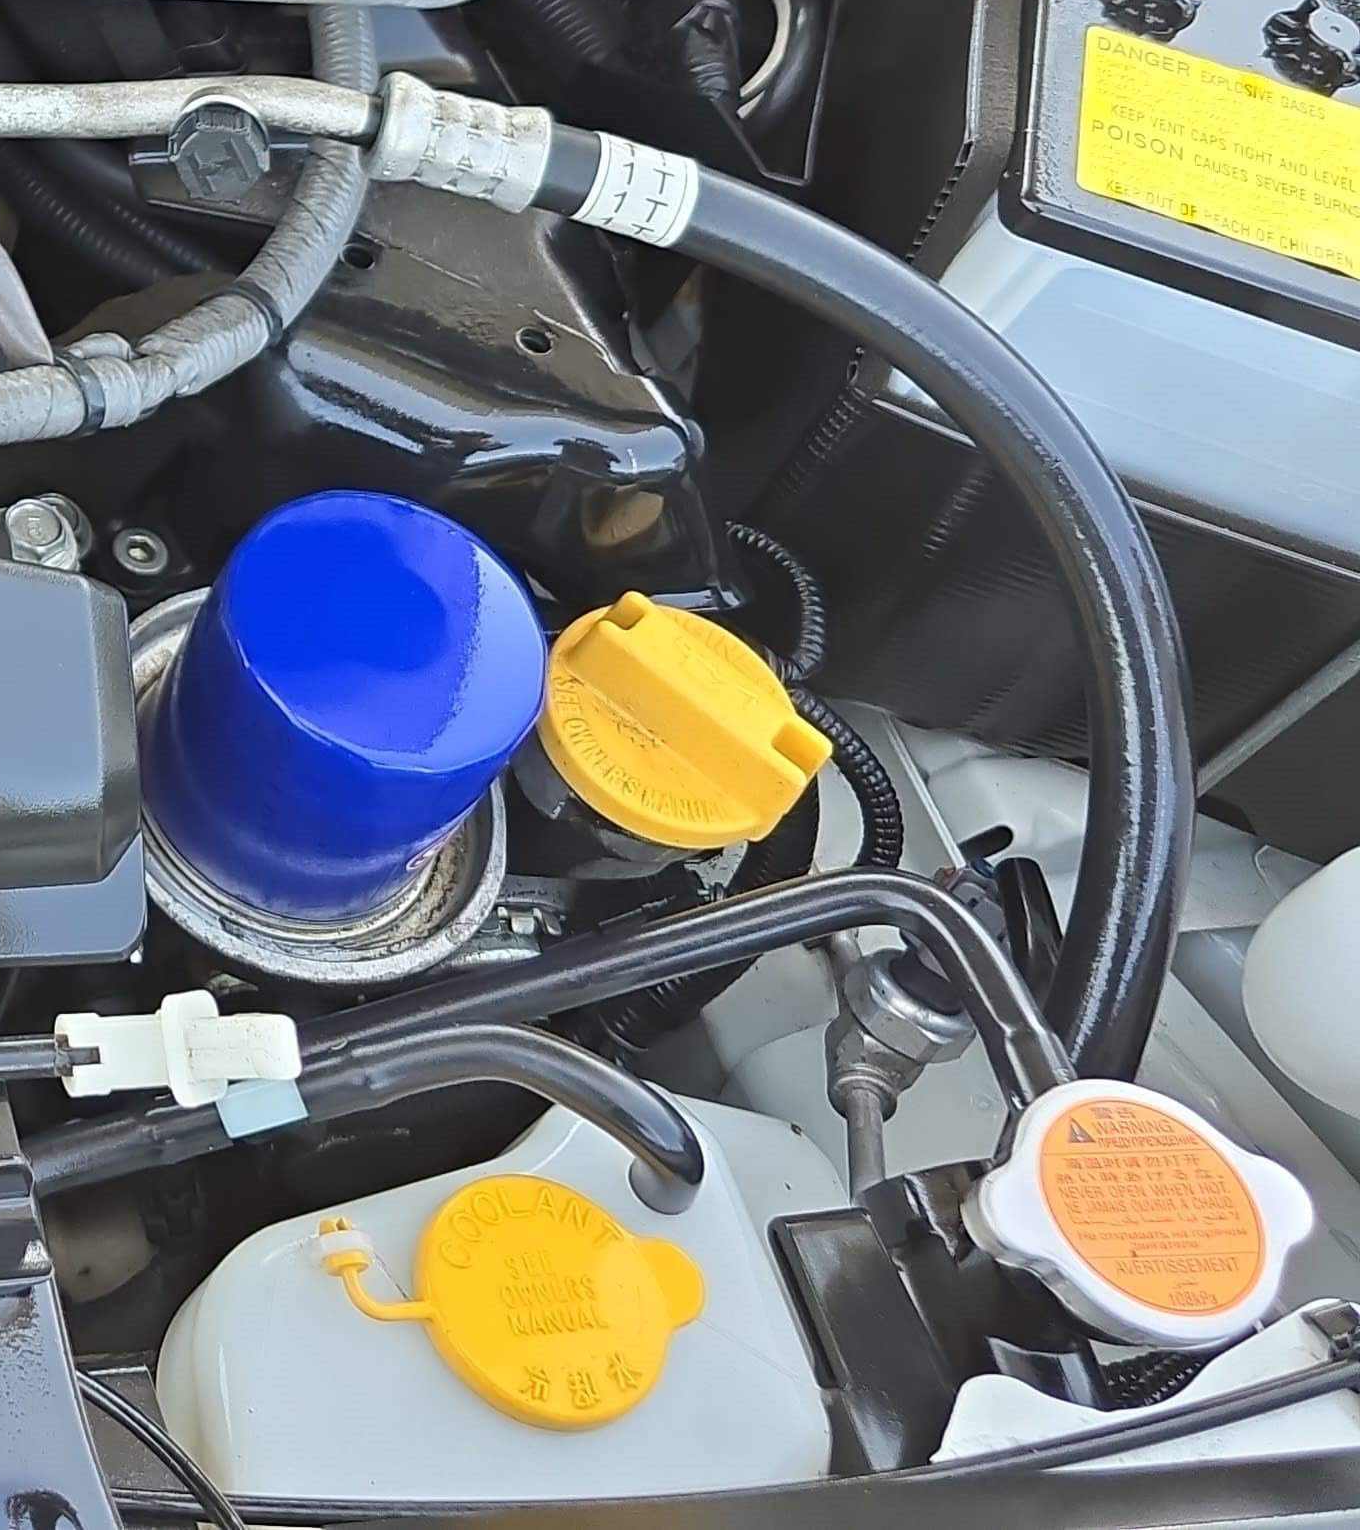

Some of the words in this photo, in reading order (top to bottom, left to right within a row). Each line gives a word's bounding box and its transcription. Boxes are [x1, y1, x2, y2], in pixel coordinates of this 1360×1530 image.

[1096, 36, 1190, 77] DANGER
[1200, 70, 1273, 104] EXPLOSIVE
[1280, 95, 1326, 121] GASES
[1091, 119, 1184, 161] POISON
[1193, 153, 1249, 183] CAUSES
[1255, 173, 1306, 201] SEVERE
[1110, 103, 1145, 122] KEEP
[1151, 117, 1184, 136] VENT
[1190, 128, 1227, 151] CAPS
[1232, 142, 1273, 167] TIGHT
[1279, 158, 1308, 177] AND
[1313, 169, 1357, 193] LEVEL
[1105, 179, 1141, 196] KEEP
[1146, 191, 1174, 210] OUT
[1179, 201, 1198, 218] OF
[1256, 228, 1275, 243] OF
[1279, 235, 1354, 270] CHILDREN
[1091, 1120, 1175, 1135] WARNING
[1058, 1185, 1104, 1200] NEVER
[1109, 1184, 1146, 1199] OPEN
[1149, 1183, 1195, 1196] WHEN
[1086, 1199, 1128, 1213] JAMAIS
[1130, 1198, 1175, 1212] OUVRIR
[439, 1186, 626, 1270] COOLANT
[504, 1249, 556, 1281] SEE
[1117, 1257, 1241, 1275] AVERTISSEMENT
[1168, 1290, 1218, 1306] 108kPa
[506, 1303, 611, 1337] MANUAL
